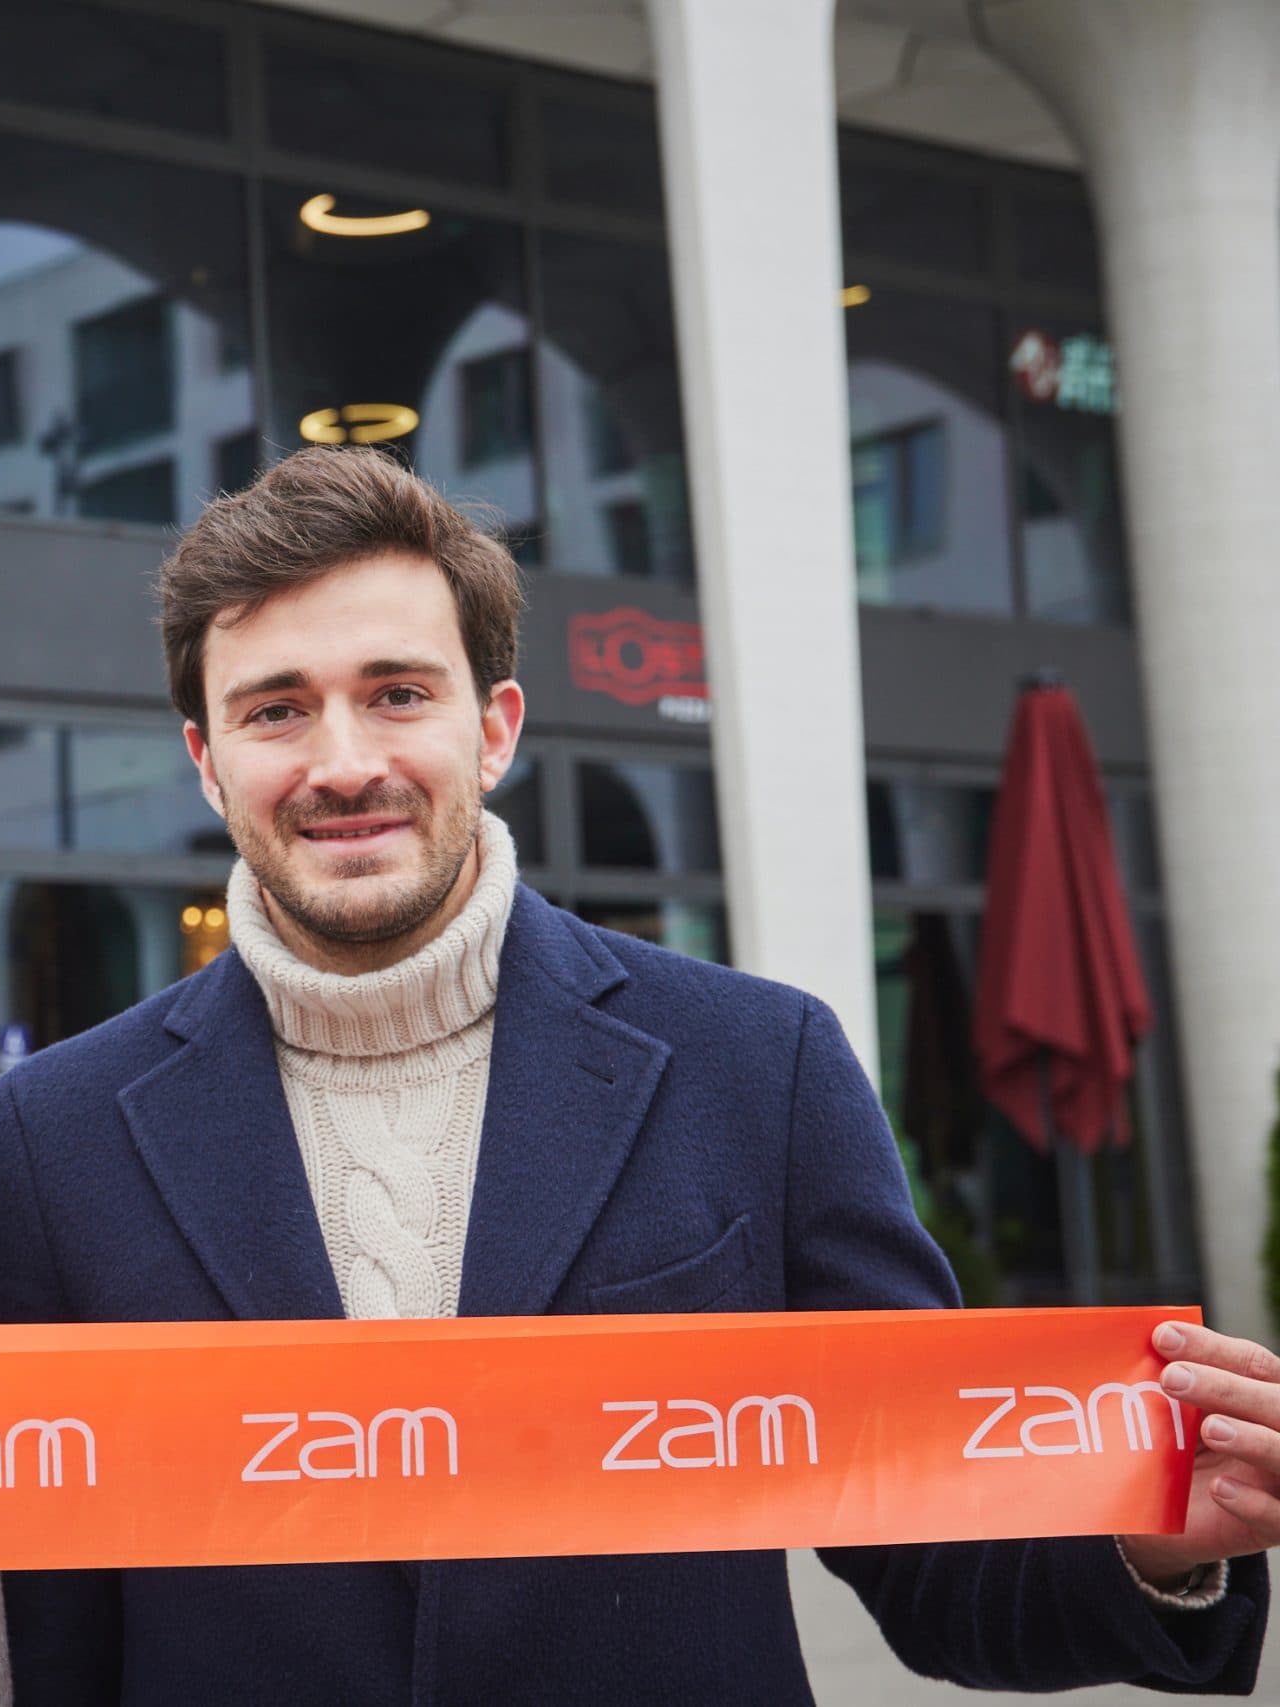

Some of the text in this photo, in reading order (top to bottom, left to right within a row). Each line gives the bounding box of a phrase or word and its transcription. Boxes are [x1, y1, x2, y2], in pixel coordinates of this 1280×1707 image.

[241, 1407, 458, 1481] zam
[601, 1395, 818, 1470] zam
[959, 1381, 1185, 1458] zam
